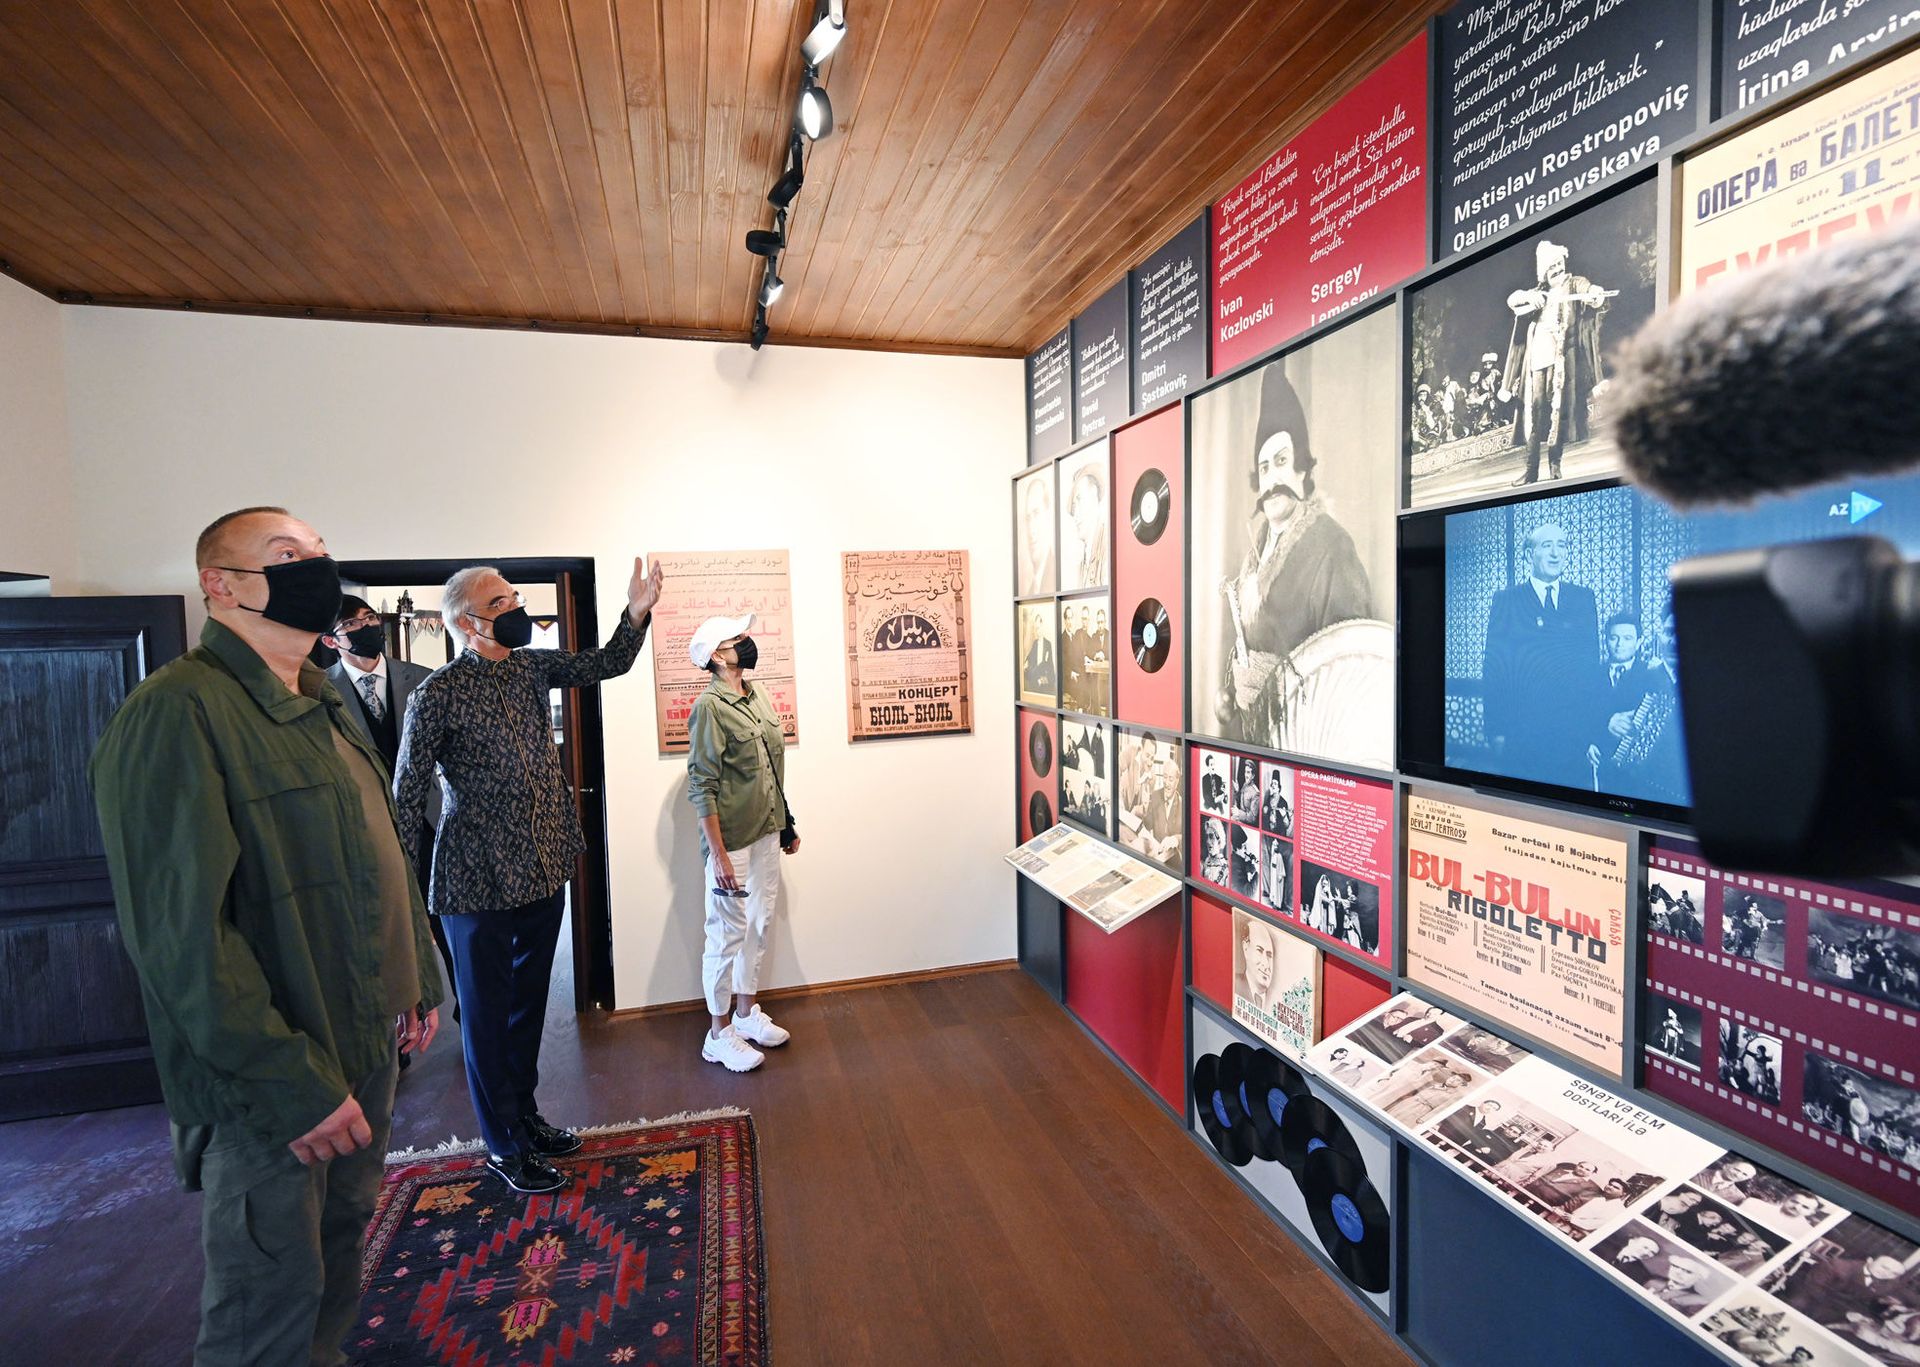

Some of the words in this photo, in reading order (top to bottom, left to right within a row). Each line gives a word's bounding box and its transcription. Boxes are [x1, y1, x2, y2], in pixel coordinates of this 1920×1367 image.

[1522, 2, 1556, 44] Belə
[1738, 0, 1837, 70] uzaqlarda
[1453, 64, 1518, 116] insanların
[1520, 15, 1589, 72] xatirəsinə
[1453, 100, 1507, 145] yanaşan
[1511, 85, 1526, 101] və
[1529, 63, 1557, 90] onu
[1392, 157, 1403, 170] və
[1454, 167, 1536, 225] Mstislav
[1541, 84, 1689, 177] Rostropoviç
[1697, 157, 1778, 221] ОПЕРА
[1820, 93, 1920, 168] БАЛЕТ
[1838, 158, 1885, 197] 11
[1453, 213, 1510, 253] Qalina
[1311, 263, 1362, 303] Sergey
[1220, 294, 1243, 319] İvan
[1220, 299, 1274, 342] Kozlovski
[1141, 361, 1166, 386] Dmitri
[1829, 503, 1849, 516] AZ
[898, 685, 958, 699] КОНЦЕРТ
[870, 702, 953, 726] БЮЛЬ-БЮЛЬ
[1301, 770, 1318, 779] OPERA
[1492, 828, 1517, 840] Bazar
[1448, 889, 1607, 964] RIGOLETTO
[1562, 1089, 1624, 1125] DOSTLARI
[1623, 1121, 1647, 1136] İLƏ
[1570, 1079, 1615, 1103] SƏNƏT
[1614, 1099, 1634, 1114] VƏ
[1633, 1111, 1667, 1130] ELM
